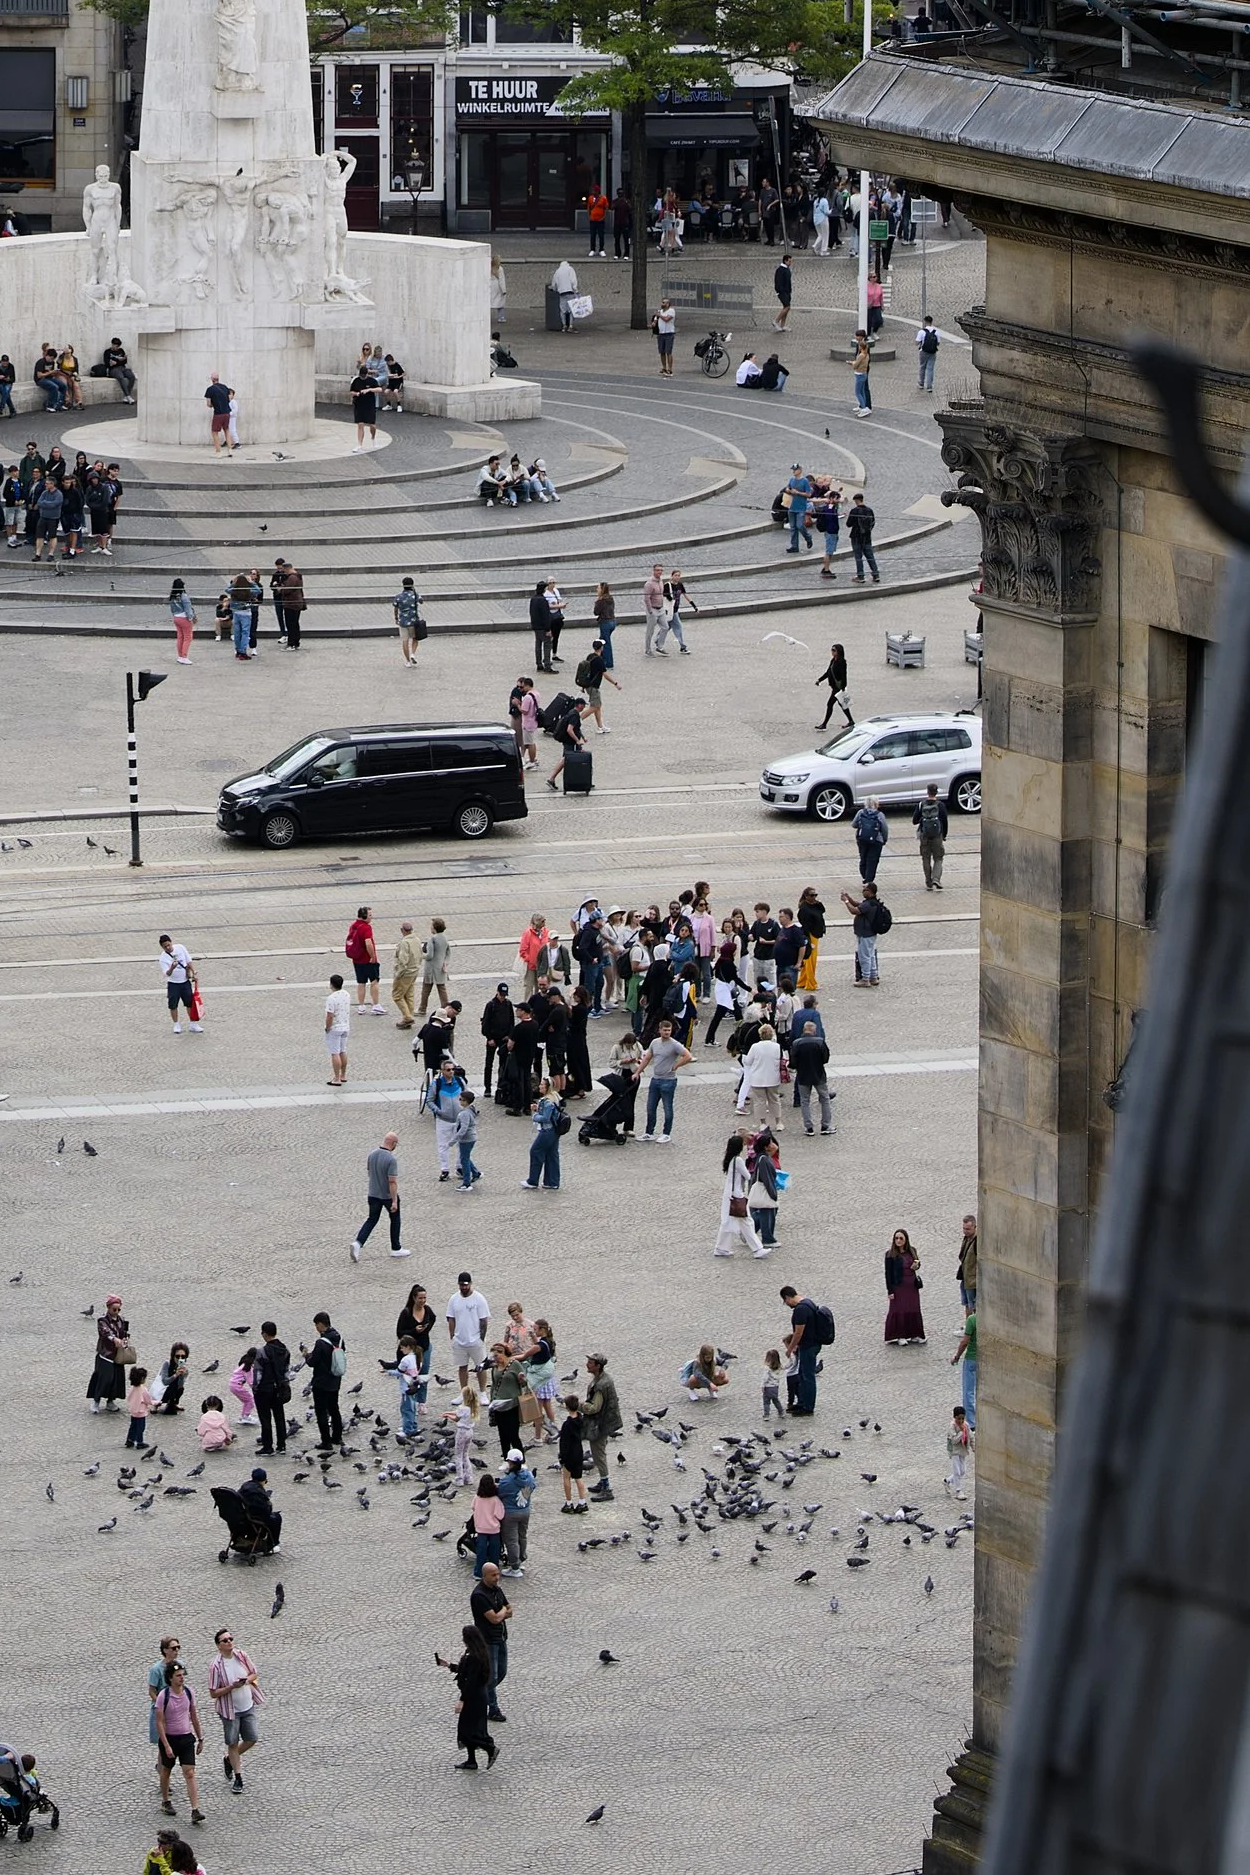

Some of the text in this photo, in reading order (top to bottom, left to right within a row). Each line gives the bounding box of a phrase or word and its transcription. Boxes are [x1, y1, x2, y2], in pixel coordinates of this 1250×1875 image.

[469, 80, 538, 99] TE HUUR
[457, 102, 550, 114] WINKELRUIMTE
